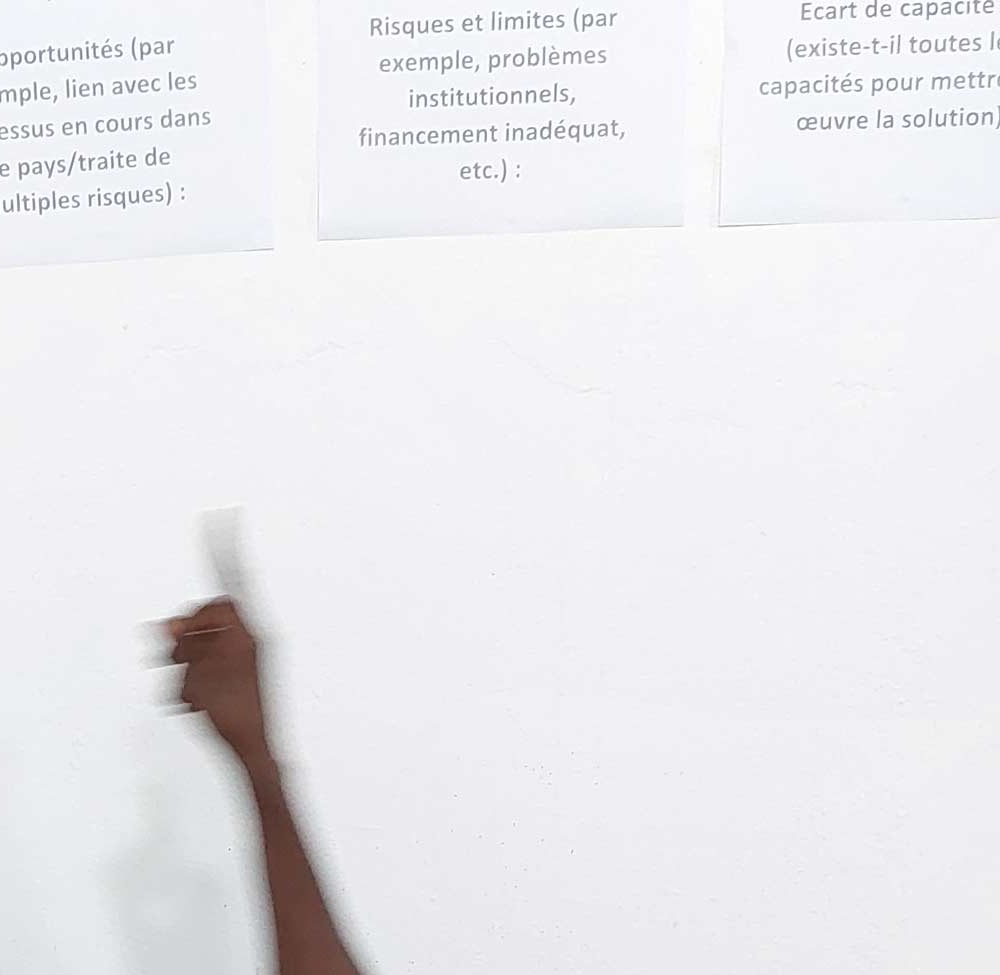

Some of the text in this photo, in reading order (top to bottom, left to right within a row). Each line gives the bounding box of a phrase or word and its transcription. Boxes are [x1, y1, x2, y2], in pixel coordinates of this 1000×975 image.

[801, 2, 857, 20] Ecart
[866, 0, 891, 18] de
[371, 8, 617, 39] Risques et limites (par
[132, 37, 174, 61] (par
[380, 46, 606, 75] exemple, problèmes
[787, 34, 981, 62] (existe-t-il toutes
[66, 79, 104, 98] lien
[112, 78, 160, 95] avec
[169, 72, 196, 91] les
[410, 83, 575, 107] institutionnels,
[760, 73, 923, 99] capacités pour
[62, 121, 87, 135] en
[95, 116, 152, 133] cours
[161, 109, 210, 128] dans
[877, 109, 893, 128] la
[359, 120, 624, 146] financement inadéquat,
[18, 152, 136, 180] pays/traite
[145, 147, 170, 166] de
[460, 159, 506, 183] etc.)
[88, 182, 171, 209] risques)
